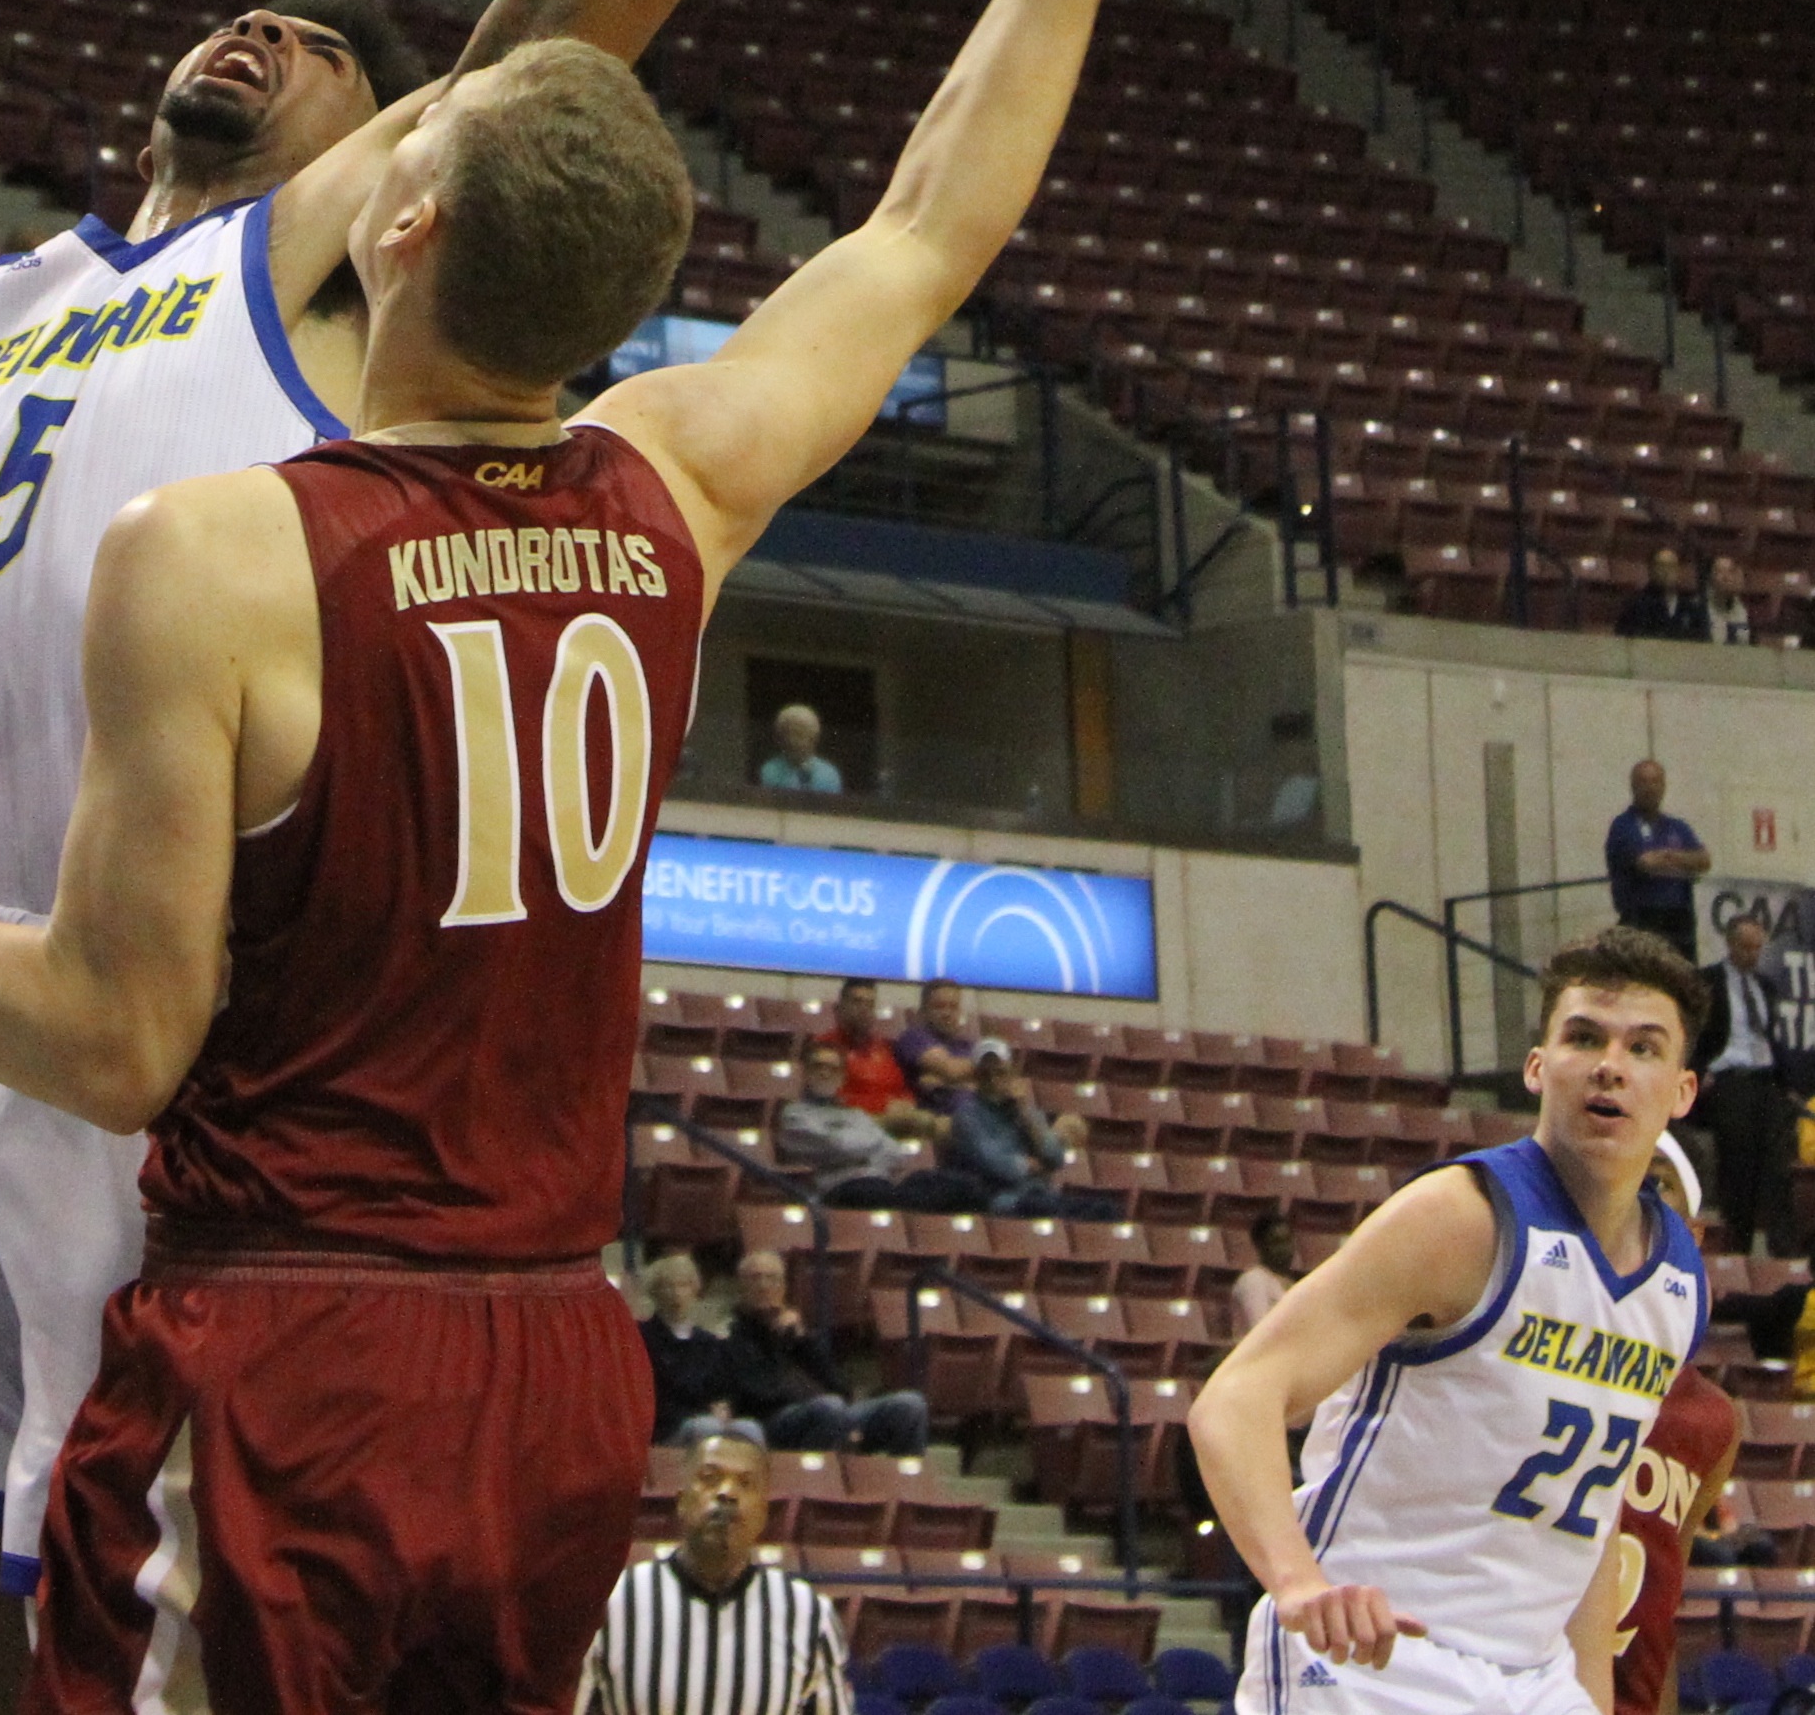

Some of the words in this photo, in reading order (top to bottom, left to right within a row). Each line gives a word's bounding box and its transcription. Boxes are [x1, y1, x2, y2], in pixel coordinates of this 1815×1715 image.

[474, 461, 544, 490] CAA
[388, 527, 668, 611] KUNDROTAS
[426, 613, 652, 928] 10
[1491, 1397, 1642, 1540] 22
[1624, 1446, 1701, 1533] ON
